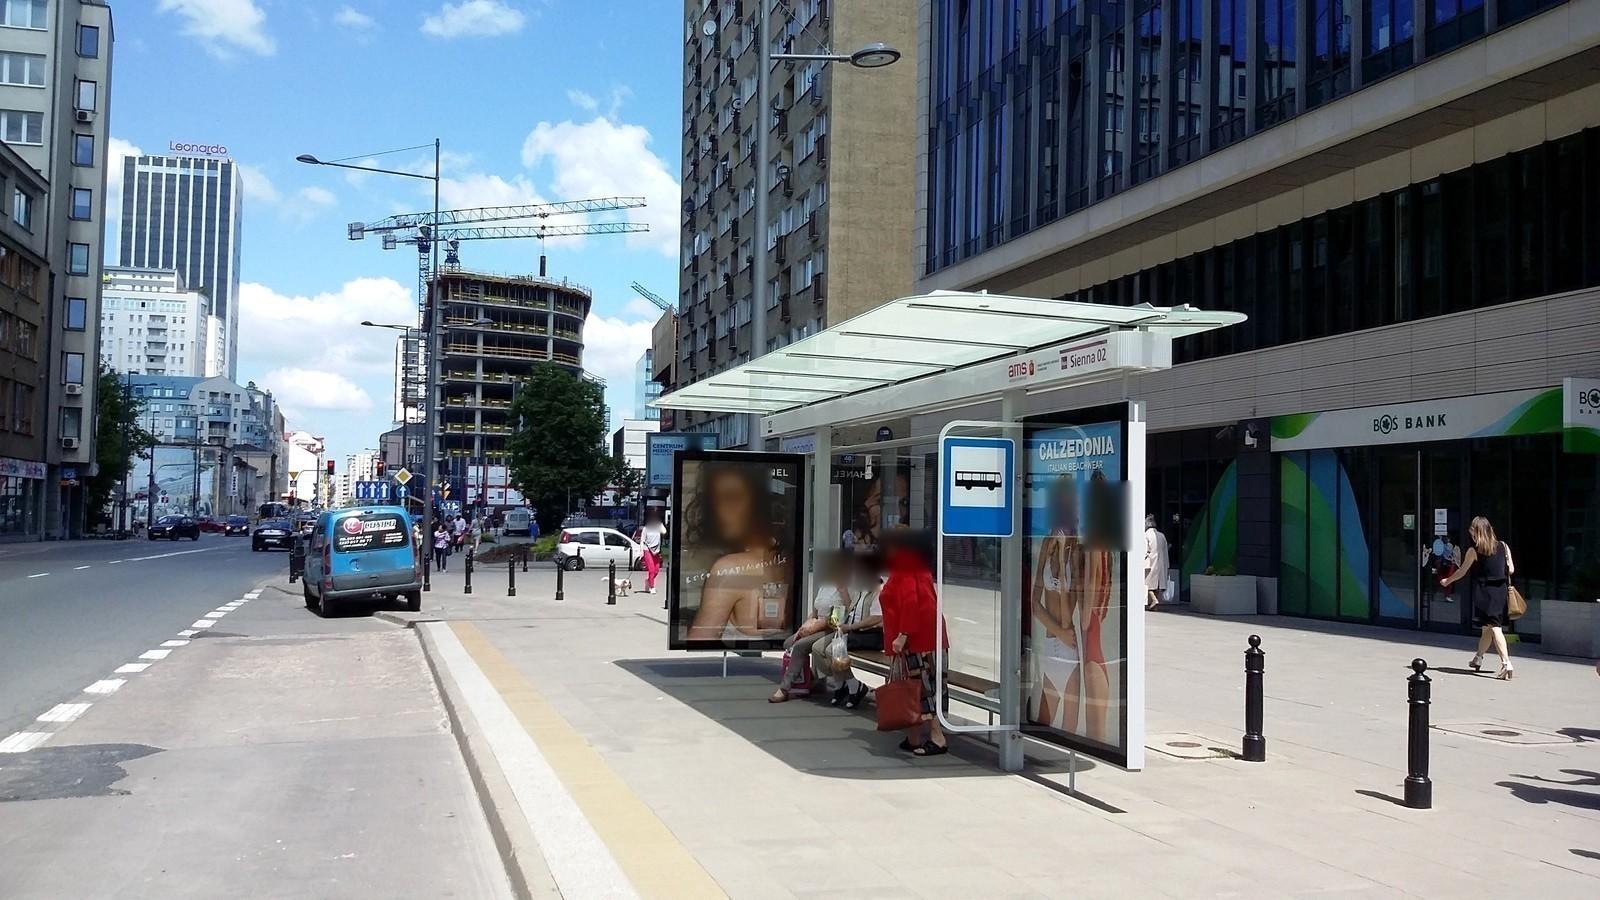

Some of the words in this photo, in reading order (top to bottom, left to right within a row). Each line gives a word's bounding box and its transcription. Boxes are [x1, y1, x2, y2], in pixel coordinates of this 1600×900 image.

[169, 140, 227, 154] Leonardo
[1070, 352, 1096, 368] Sienna
[1096, 347, 1107, 362] 02
[1008, 361, 1028, 378] ams
[1405, 413, 1447, 430] BANK
[1039, 435, 1115, 461] CALZEDONIA
